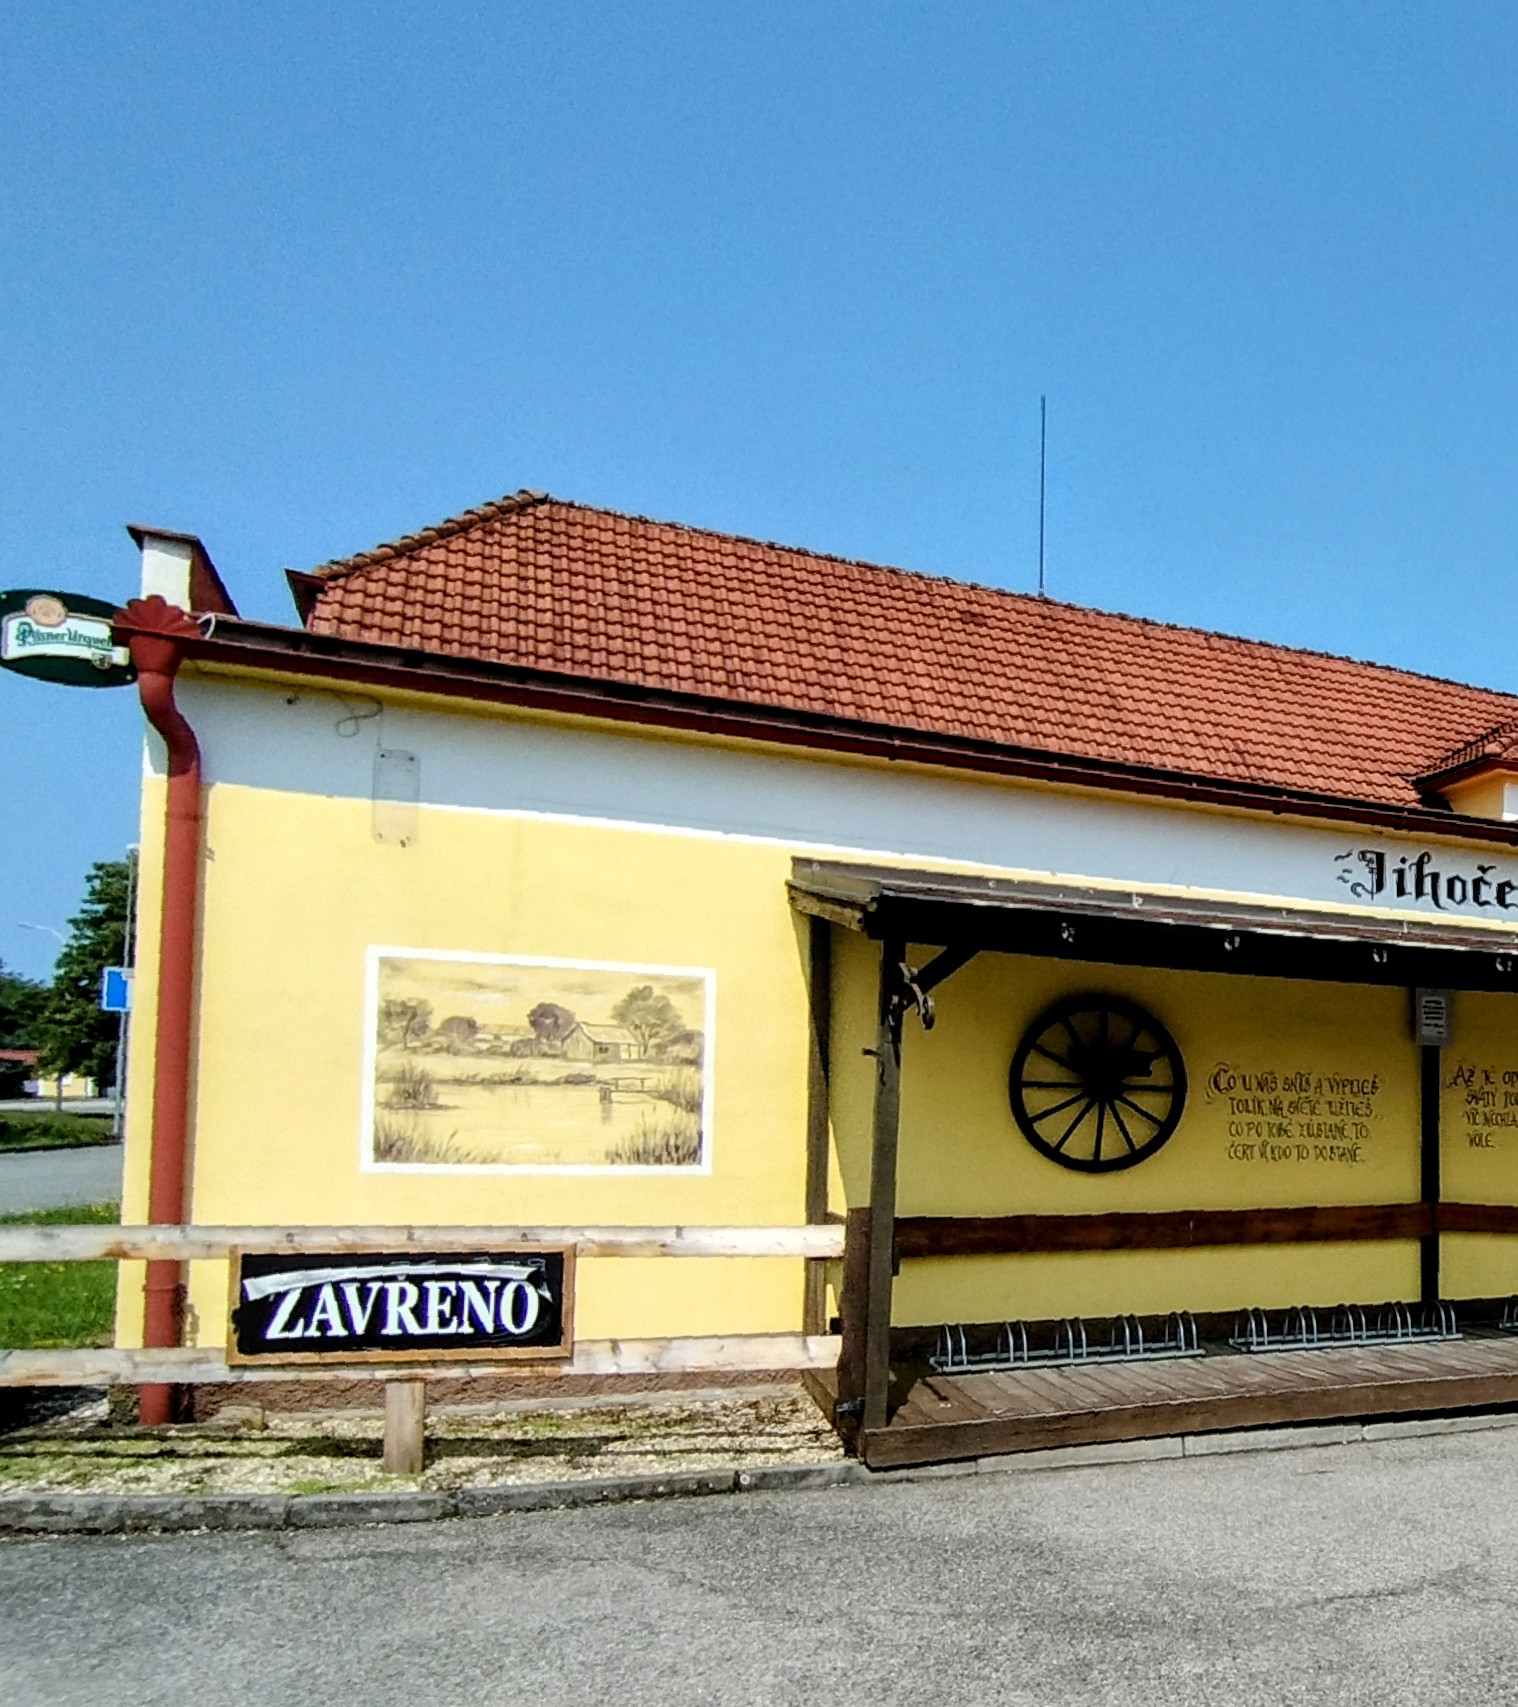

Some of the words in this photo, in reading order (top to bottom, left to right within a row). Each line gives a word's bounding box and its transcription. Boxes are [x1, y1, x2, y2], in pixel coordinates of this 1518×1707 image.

[16, 622, 67, 646] Pilsner
[1228, 1120, 1244, 1138] CO
[1246, 1121, 1264, 1138] PO
[1351, 1121, 1370, 1140] TO
[1294, 1144, 1310, 1161] TO
